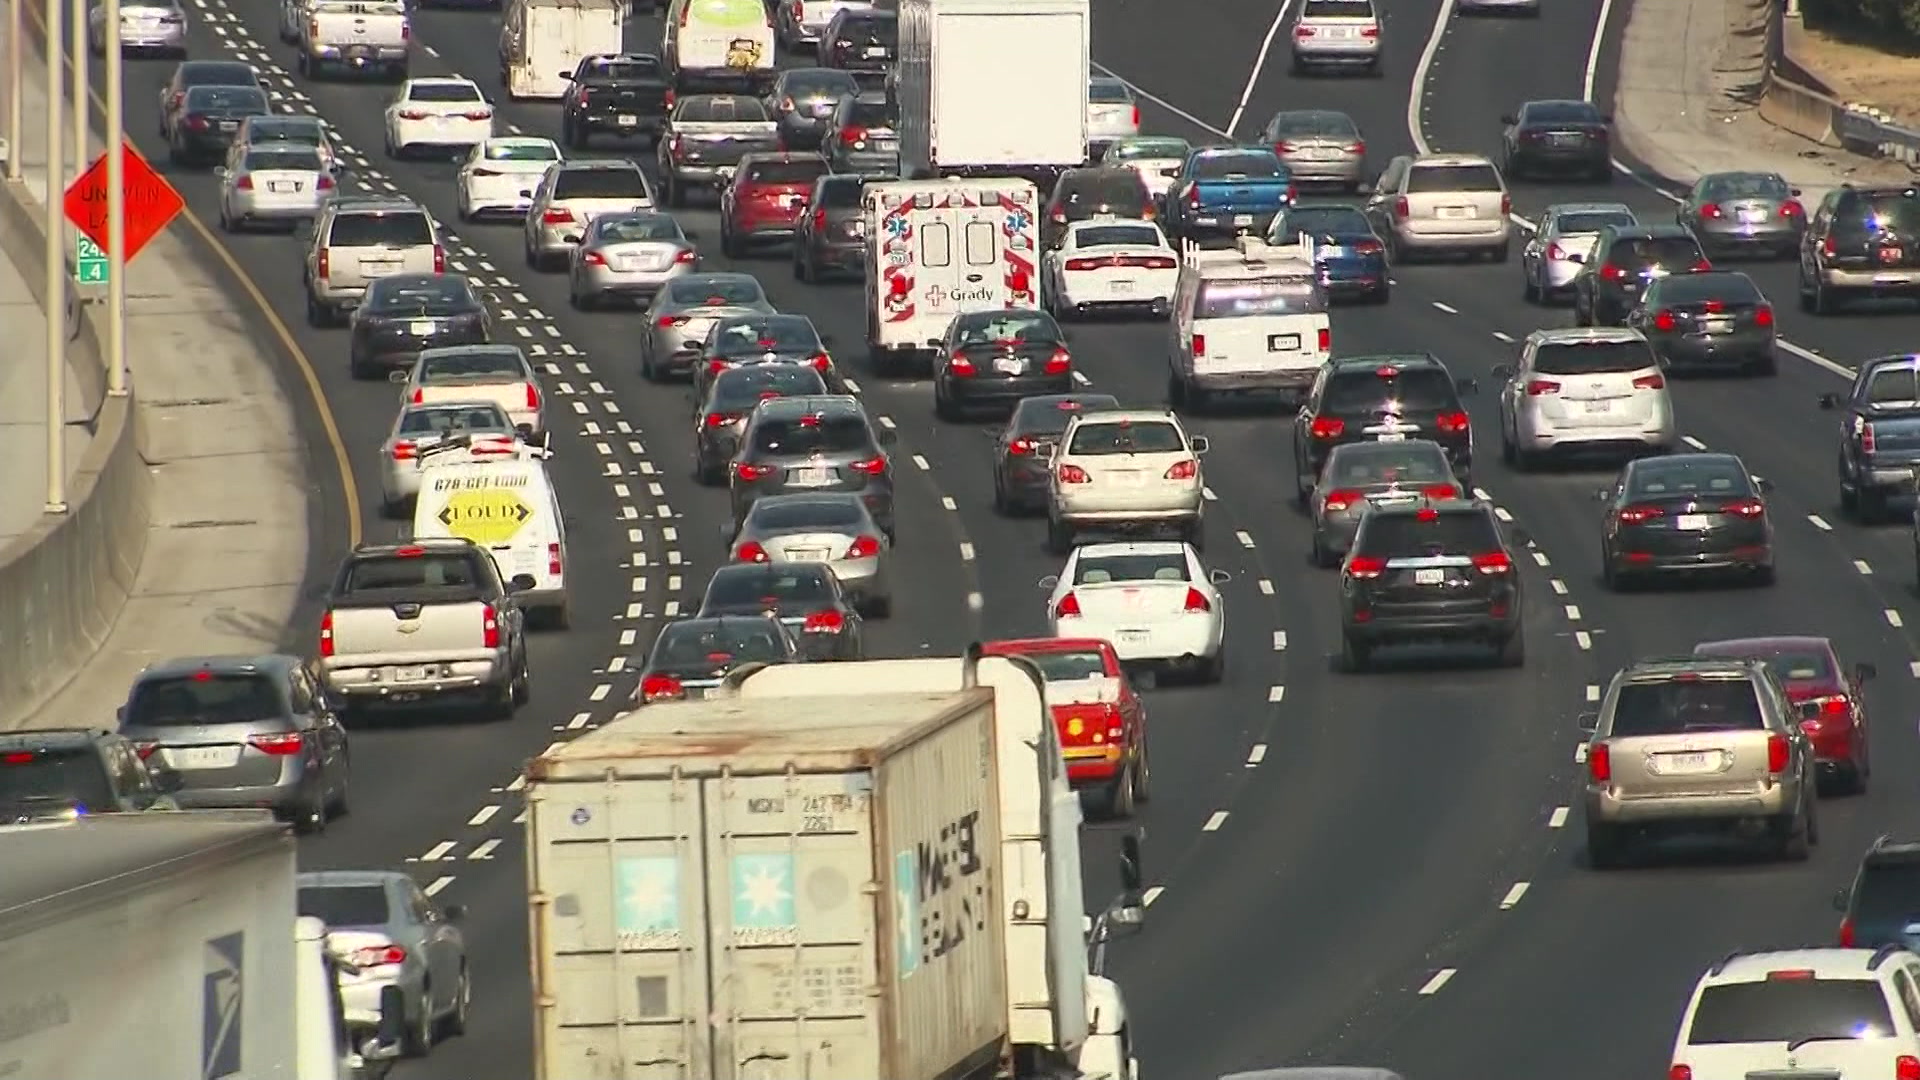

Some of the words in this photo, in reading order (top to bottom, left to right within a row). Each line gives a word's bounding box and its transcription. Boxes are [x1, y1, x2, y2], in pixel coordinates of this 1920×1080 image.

[80, 186, 160, 201] UNVEN
[950, 286, 994, 302] Grady
[453, 504, 516, 520] LOUD
